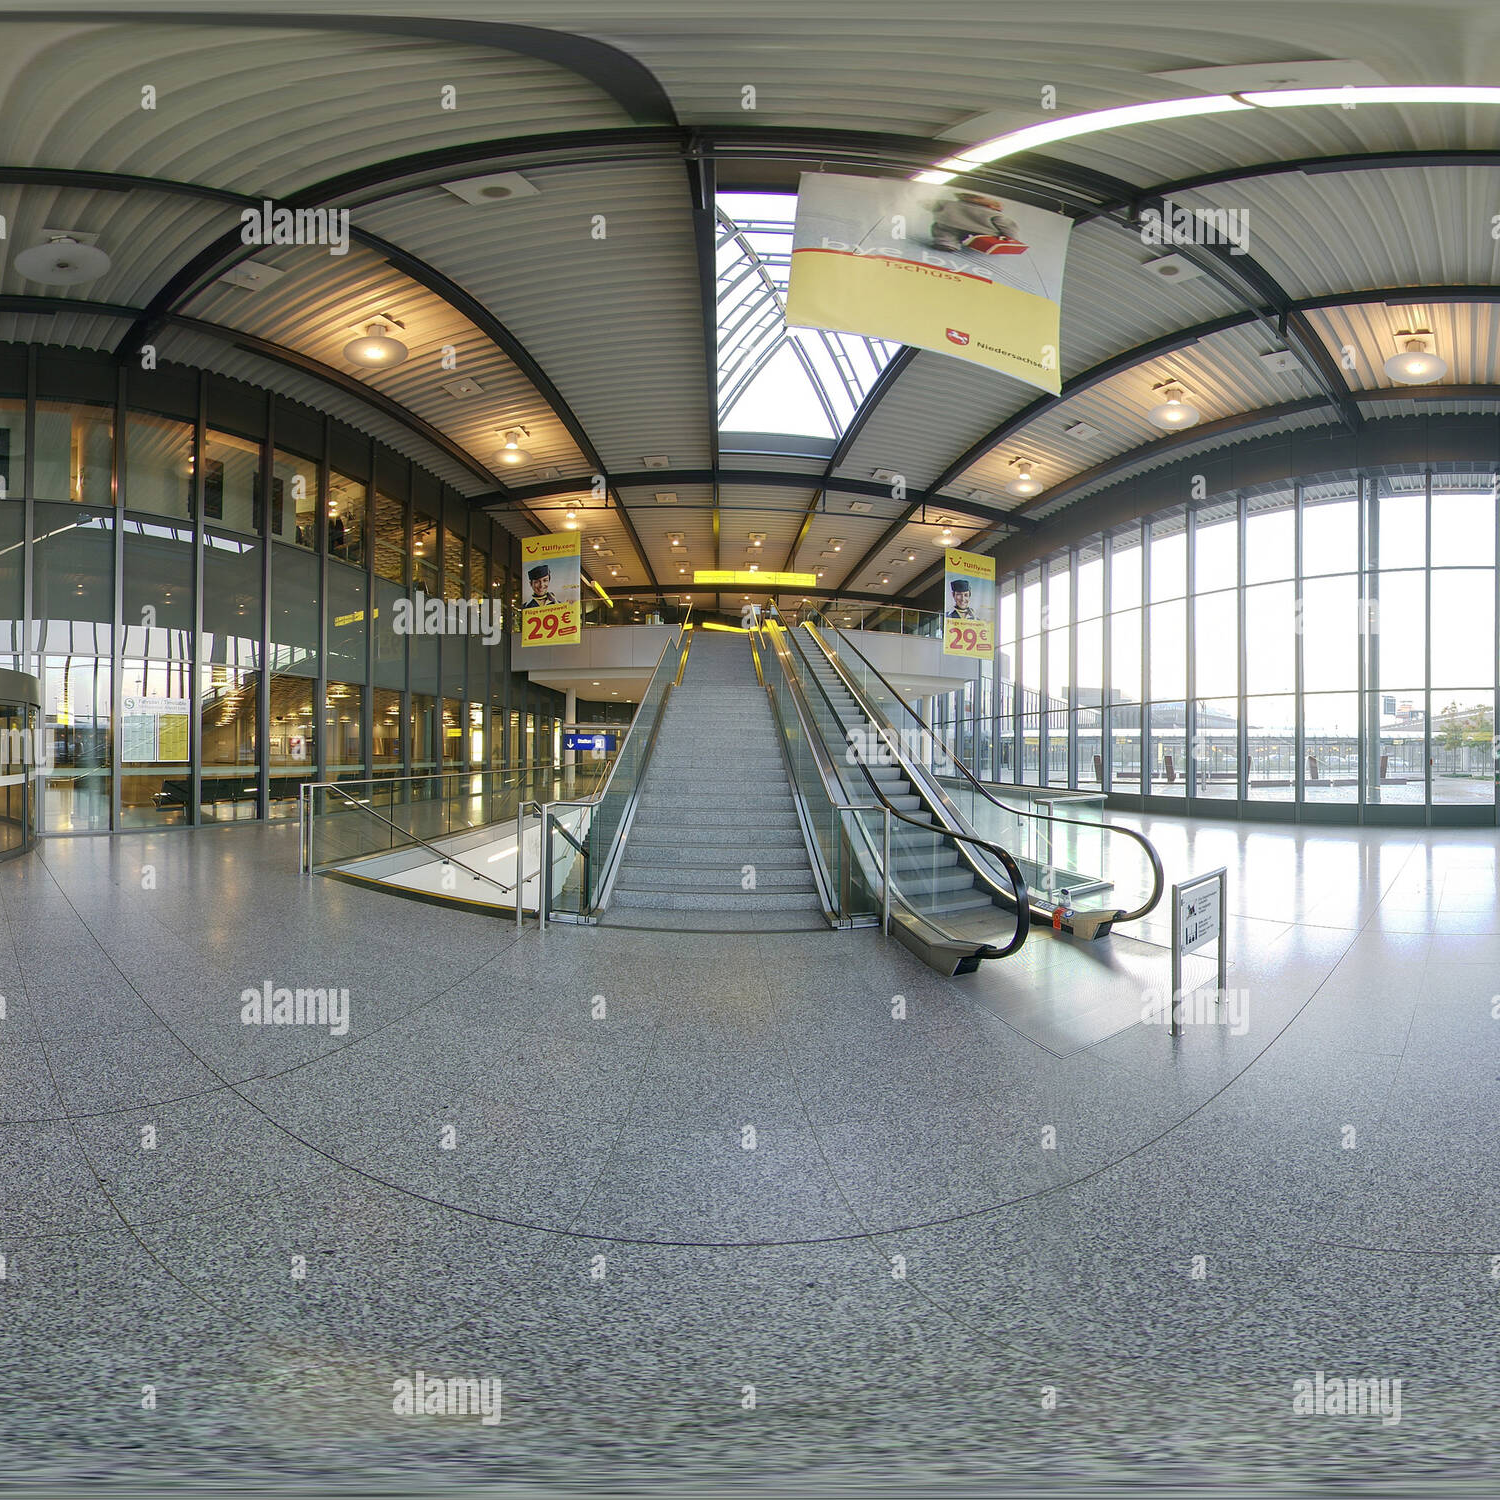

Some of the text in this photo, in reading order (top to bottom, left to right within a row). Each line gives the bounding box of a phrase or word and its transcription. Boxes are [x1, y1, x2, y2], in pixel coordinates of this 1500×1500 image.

[822, 237, 993, 278] bye bye
[527, 614, 558, 640] 29
[949, 627, 977, 650] 29
